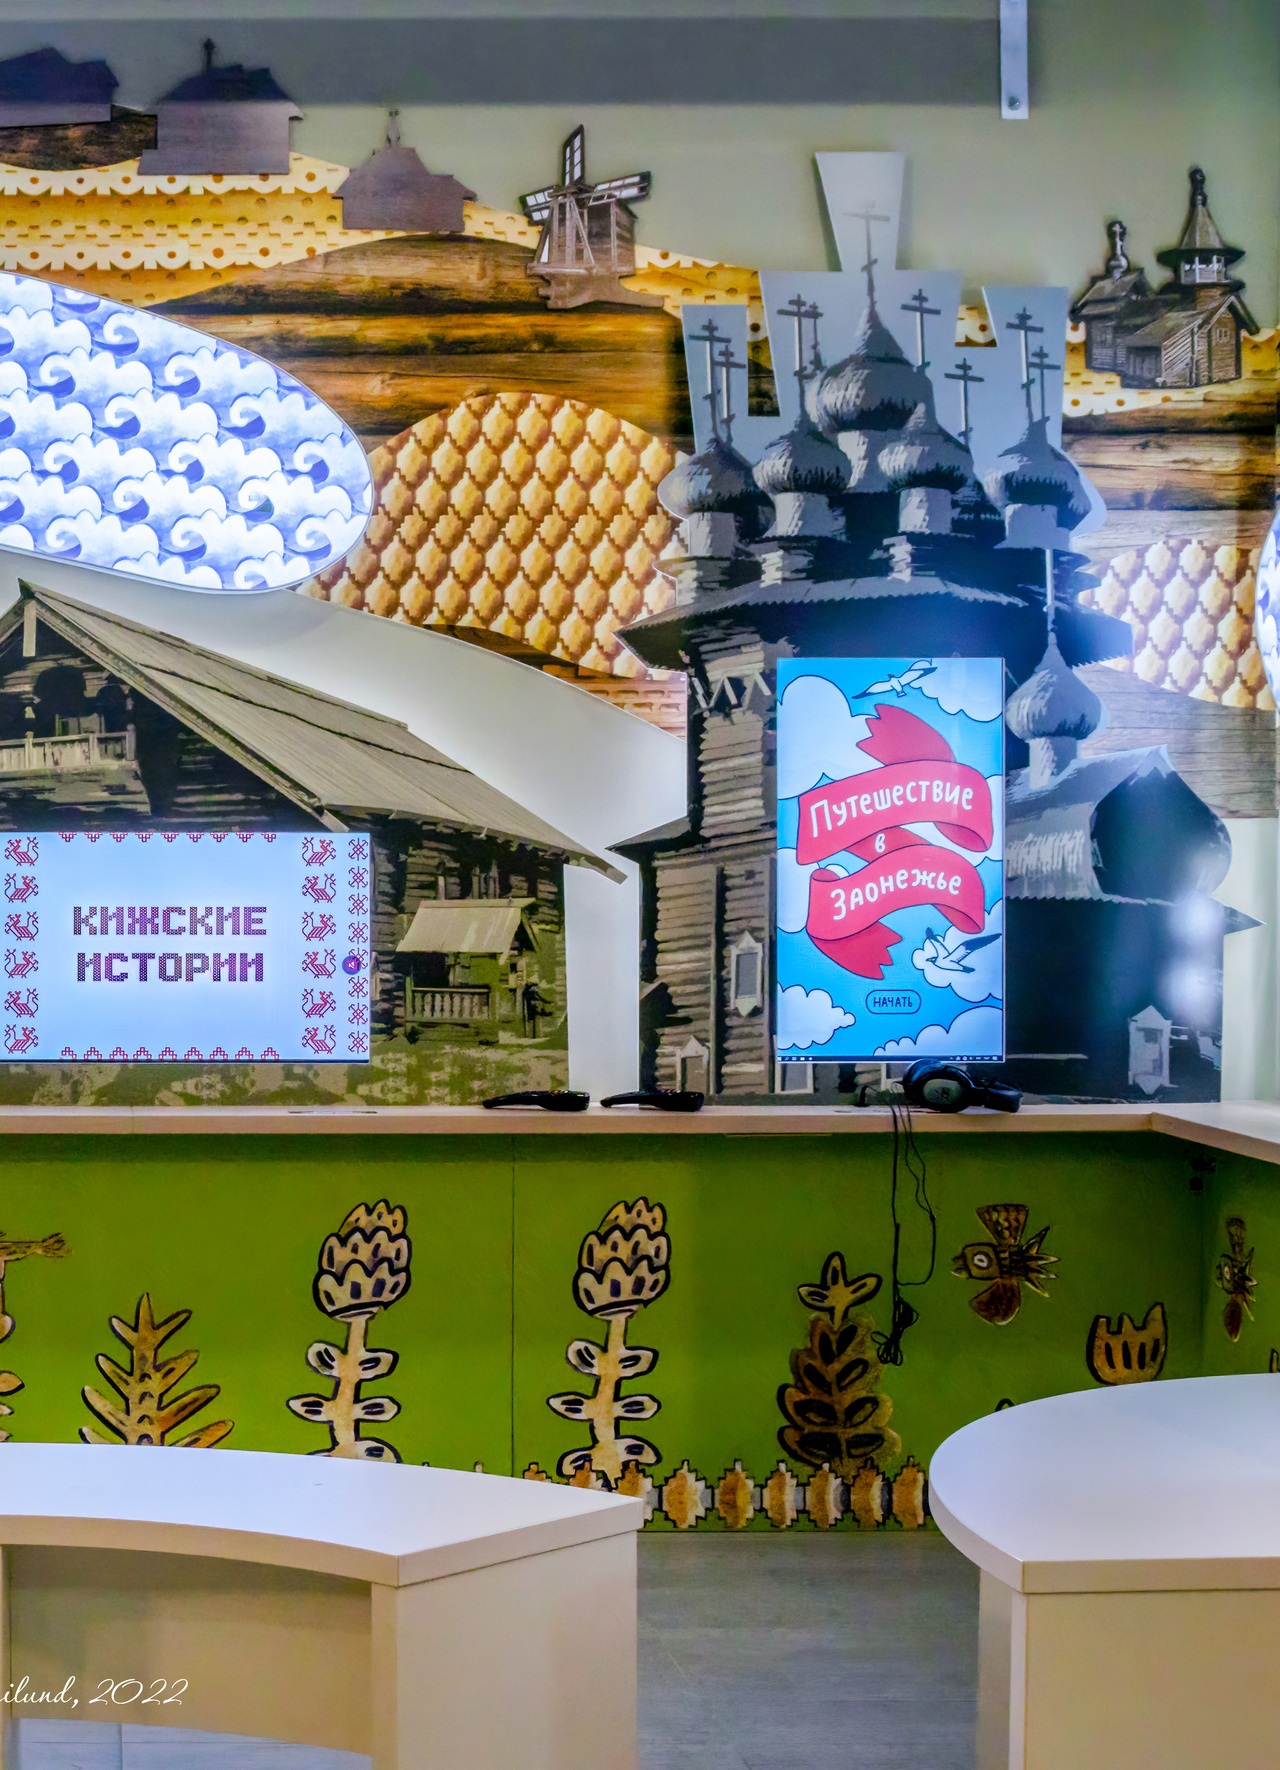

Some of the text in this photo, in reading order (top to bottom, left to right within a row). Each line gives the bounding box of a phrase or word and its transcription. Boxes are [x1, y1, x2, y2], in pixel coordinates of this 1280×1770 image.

[810, 779, 974, 838] Путешествие
[874, 833, 886, 853] в
[830, 868, 962, 921] Заонежье
[73, 906, 267, 936] КИЖСКИЕ
[77, 952, 264, 982] ИСТОРИИ
[872, 996, 914, 1008] НАЧАТЬ
